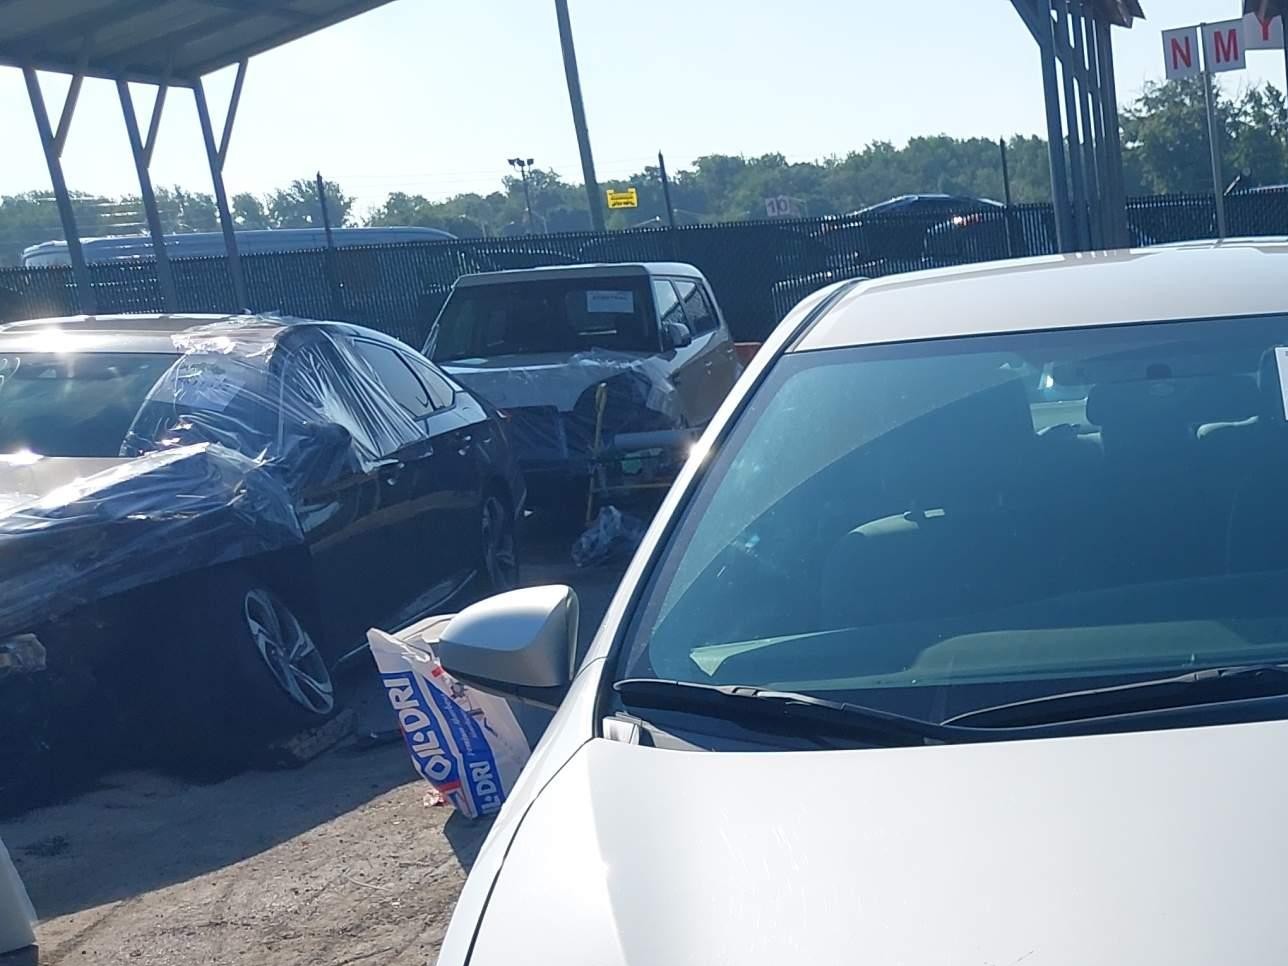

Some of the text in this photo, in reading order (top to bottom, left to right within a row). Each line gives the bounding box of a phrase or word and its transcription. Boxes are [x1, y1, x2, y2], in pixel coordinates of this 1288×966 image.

[1258, 16, 1276, 41] Y
[1171, 36, 1192, 70] N
[1214, 29, 1240, 64] M
[767, 199, 789, 214] 10
